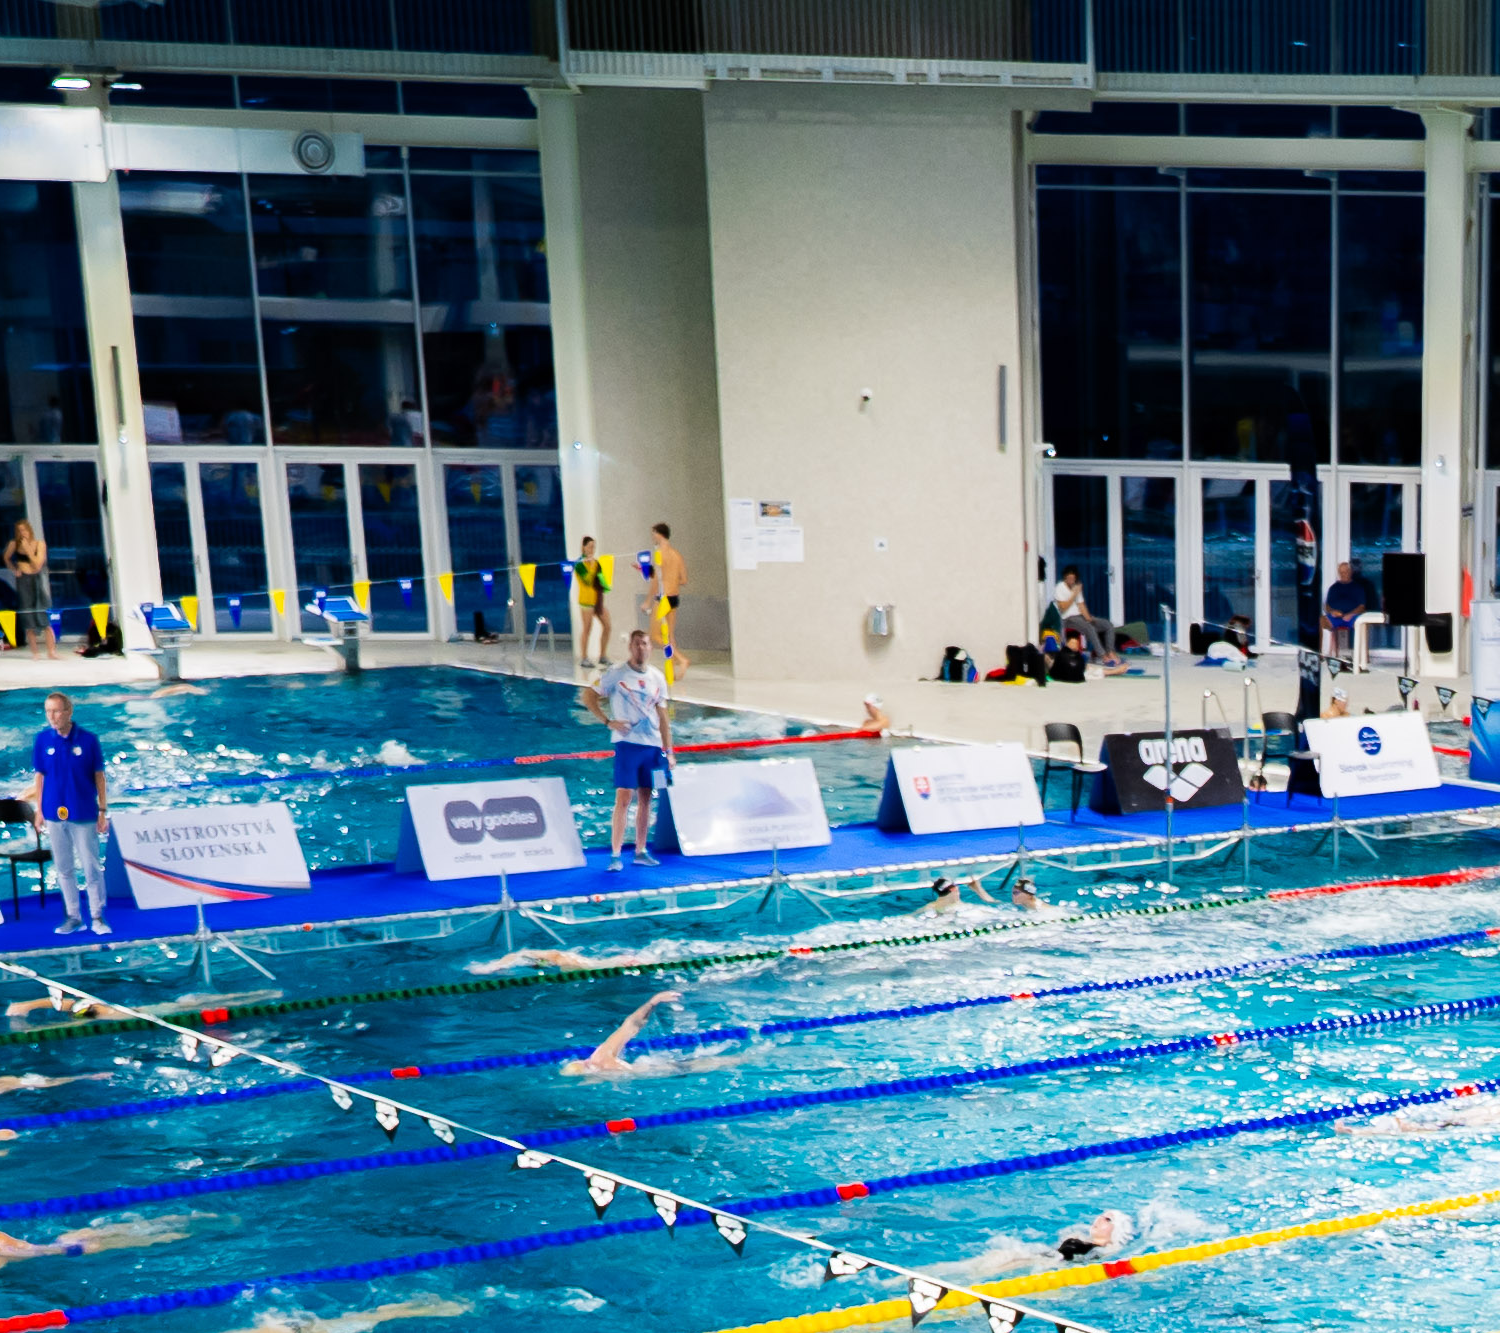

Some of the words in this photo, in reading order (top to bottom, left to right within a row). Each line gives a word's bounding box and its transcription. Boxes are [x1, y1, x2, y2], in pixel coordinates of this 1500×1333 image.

[1138, 737, 1208, 766] arena
[134, 818, 276, 845] MAJSTROVSTVÁ
[450, 816, 483, 833] very
[483, 810, 538, 831] goodies
[160, 841, 268, 862] SLOVENSKA
